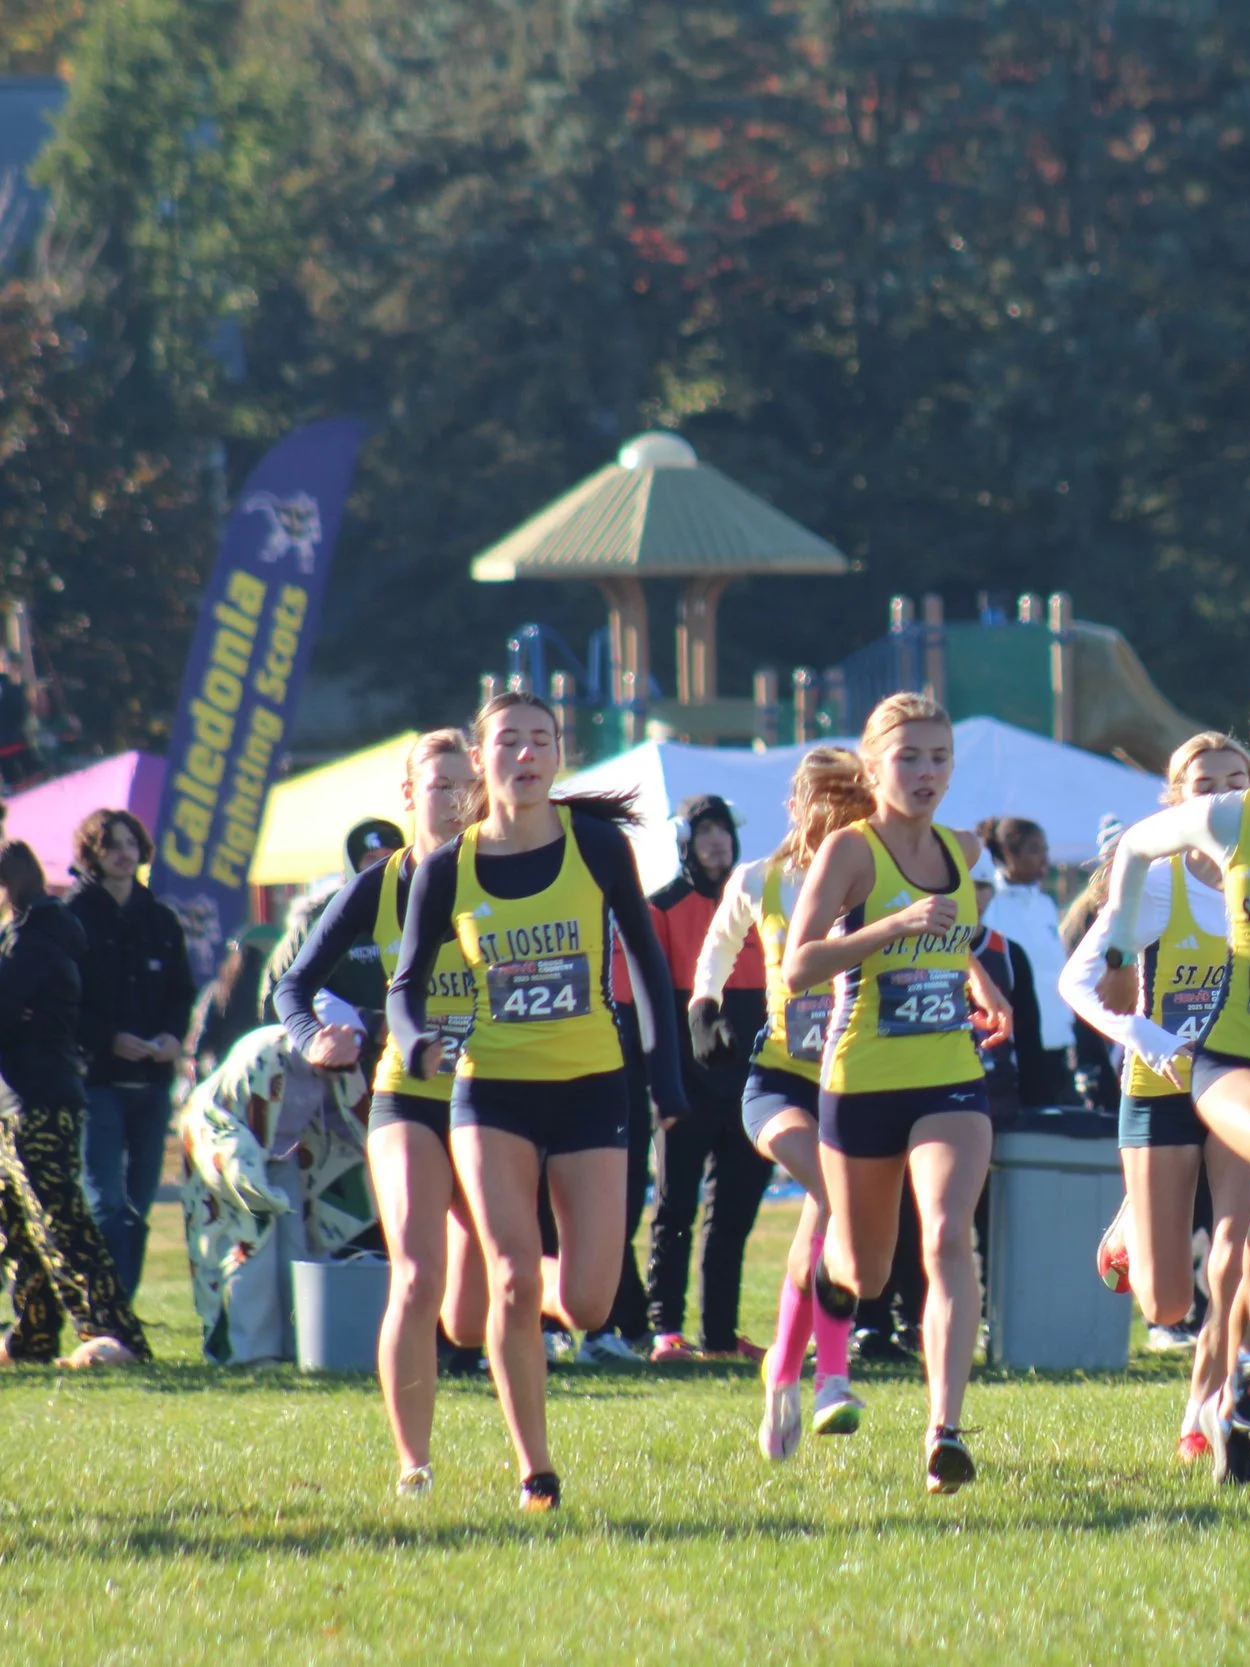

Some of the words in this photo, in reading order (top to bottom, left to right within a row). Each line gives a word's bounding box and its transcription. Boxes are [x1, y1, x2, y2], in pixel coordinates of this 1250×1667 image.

[163, 569, 267, 878] Caledonia
[209, 706, 284, 888] Fighting
[253, 582, 308, 704] Scots
[506, 920, 579, 961] JOSEPH
[1172, 965, 1198, 985] ST.
[503, 984, 578, 1017] 424
[895, 992, 956, 1024] 425
